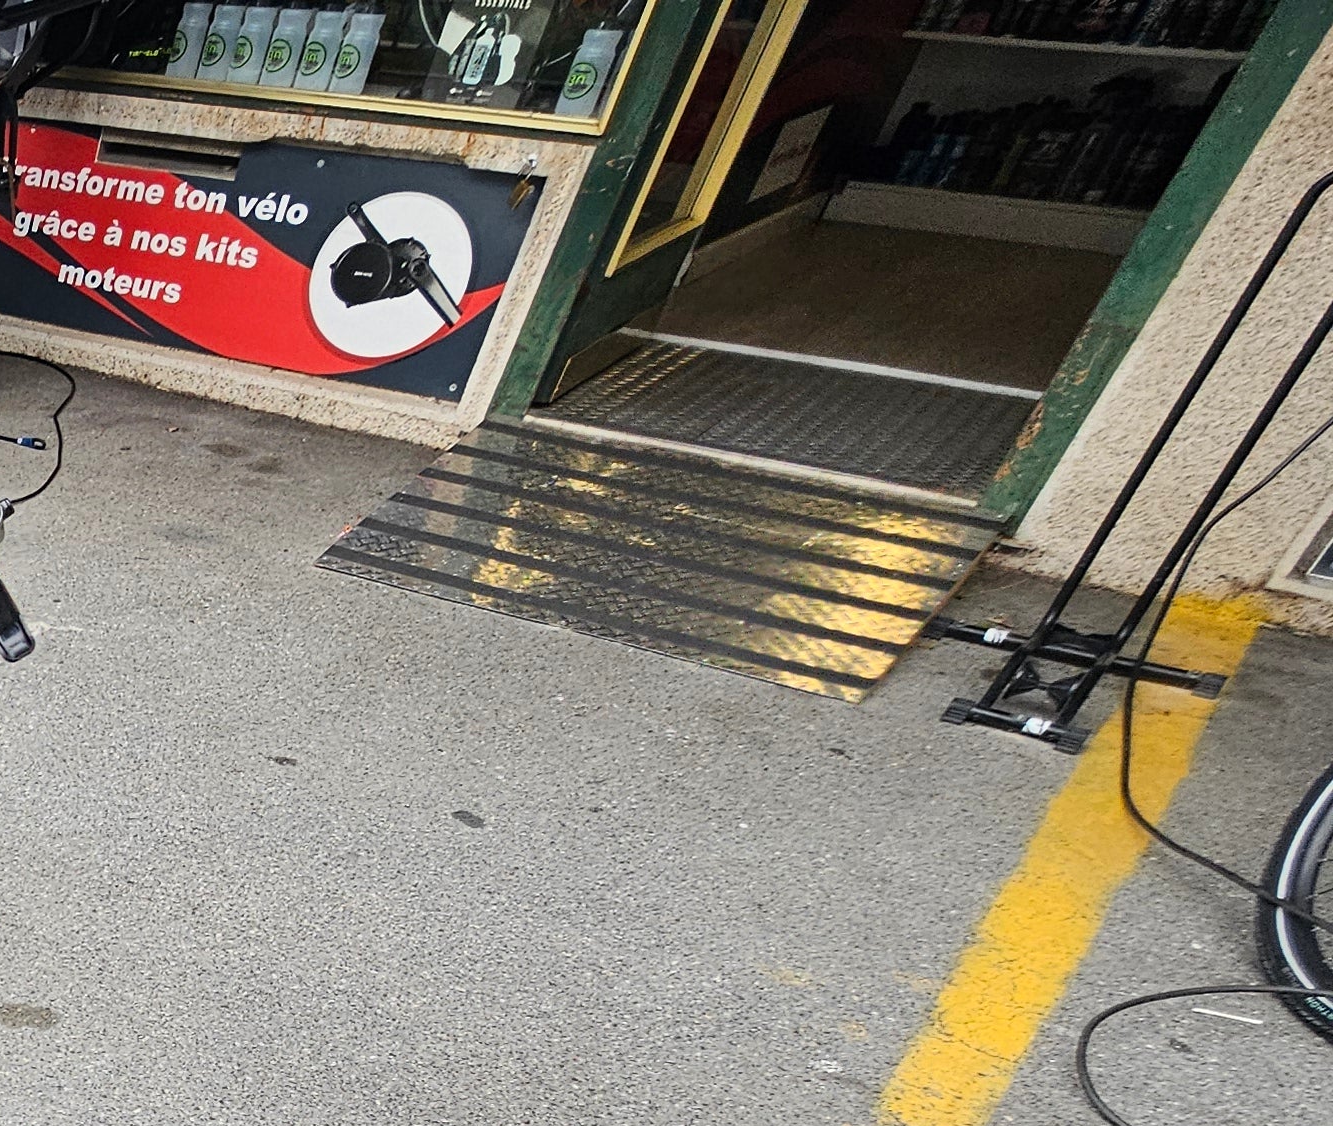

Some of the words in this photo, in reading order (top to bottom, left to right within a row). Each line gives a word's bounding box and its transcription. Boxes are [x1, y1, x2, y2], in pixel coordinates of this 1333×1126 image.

[2, 156, 165, 205] ransforme
[174, 181, 227, 214] ton
[237, 192, 309, 226] vélo
[12, 210, 96, 242] grâce
[103, 219, 123, 247] à
[130, 230, 187, 258] nos
[194, 233, 259, 269] kits
[57, 261, 183, 304] moteurs
